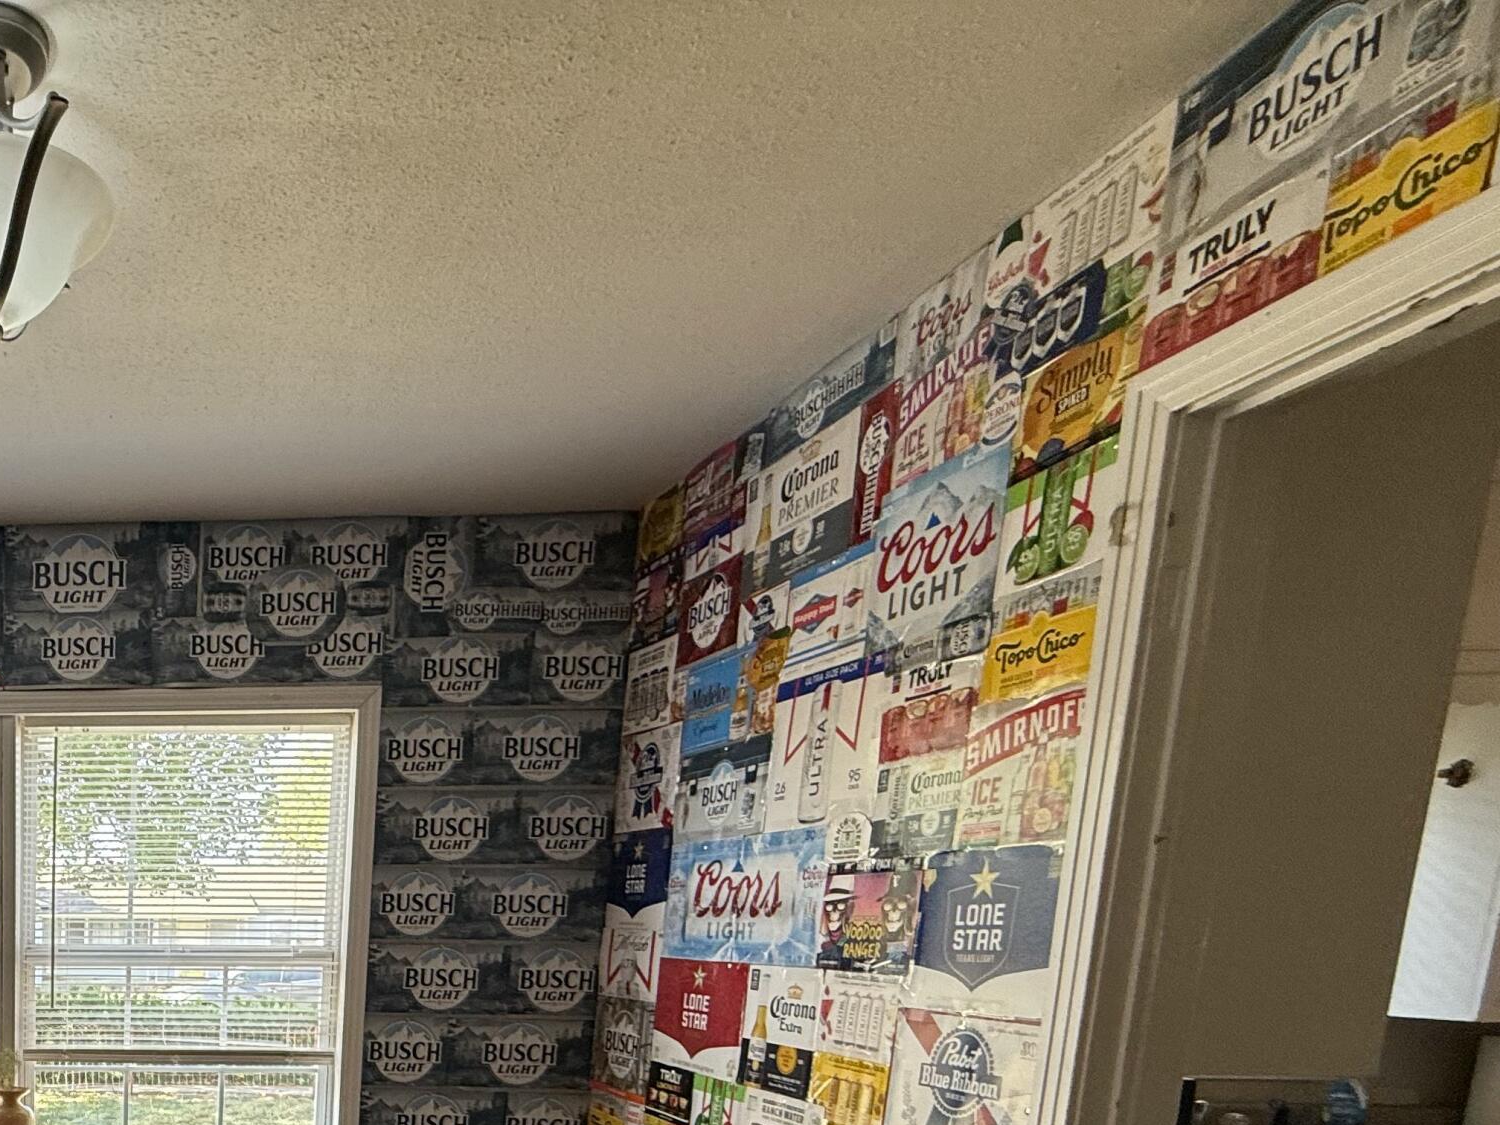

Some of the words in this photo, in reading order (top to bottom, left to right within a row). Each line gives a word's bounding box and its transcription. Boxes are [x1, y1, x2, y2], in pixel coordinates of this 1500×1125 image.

[1247, 13, 1384, 147] BUSCH
[1269, 82, 1351, 151] LIGHT
[1321, 196, 1392, 254] Topo
[1393, 134, 1497, 211] Chico
[1188, 199, 1277, 272] TRULY
[1036, 341, 1115, 413] Simply
[1057, 388, 1088, 414] SPIKED
[903, 422, 927, 458] ICE
[781, 449, 840, 503] Corona
[778, 477, 839, 527] PREMIER
[516, 541, 594, 564] BUSCH
[877, 502, 997, 593] Coors
[35, 561, 126, 589] BUSCH
[411, 550, 423, 594] LIGHT
[422, 532, 447, 611] BUSCH
[531, 565, 577, 577] LIGHT
[53, 590, 106, 604] LIGHT
[262, 591, 335, 614] BUSCH
[888, 563, 967, 620] LIGHT
[276, 615, 320, 626] LIGHT
[689, 588, 732, 631] BUSCH
[995, 640, 1037, 674] Topo
[1035, 628, 1086, 664] Chico
[545, 655, 622, 678] BUSCH
[805, 672, 824, 687] ULTRA
[825, 668, 840, 682] SIZE
[840, 663, 859, 677] PACK
[908, 663, 954, 689] TRULY
[560, 678, 605, 690] LIGHT
[692, 682, 731, 706] Modelo
[505, 736, 579, 759] BUSCH
[808, 718, 829, 796] ULTRA
[519, 759, 563, 770] LIGHT
[702, 780, 738, 807] BUSCH
[910, 769, 962, 794] Corona
[971, 776, 1002, 807] ICE
[626, 864, 647, 879] LONE
[625, 880, 645, 894] STAR
[693, 859, 782, 918] Coors
[381, 892, 454, 914] BUSCH
[955, 903, 1006, 926] LONE
[396, 914, 438, 925] LIGHT
[706, 922, 756, 940] LIGHT
[844, 921, 883, 939] VOODOO
[843, 942, 881, 960] RANGER
[952, 928, 1003, 951] STAR
[683, 993, 711, 1013] LONE
[770, 995, 817, 1021] Corona
[681, 1012, 709, 1031] STAR
[778, 1018, 803, 1035] Extra
[605, 1030, 640, 1056] BUSCH
[942, 1038, 983, 1070] Pabst
[921, 1065, 949, 1089] Blue
[950, 1070, 999, 1100] Ribbon
